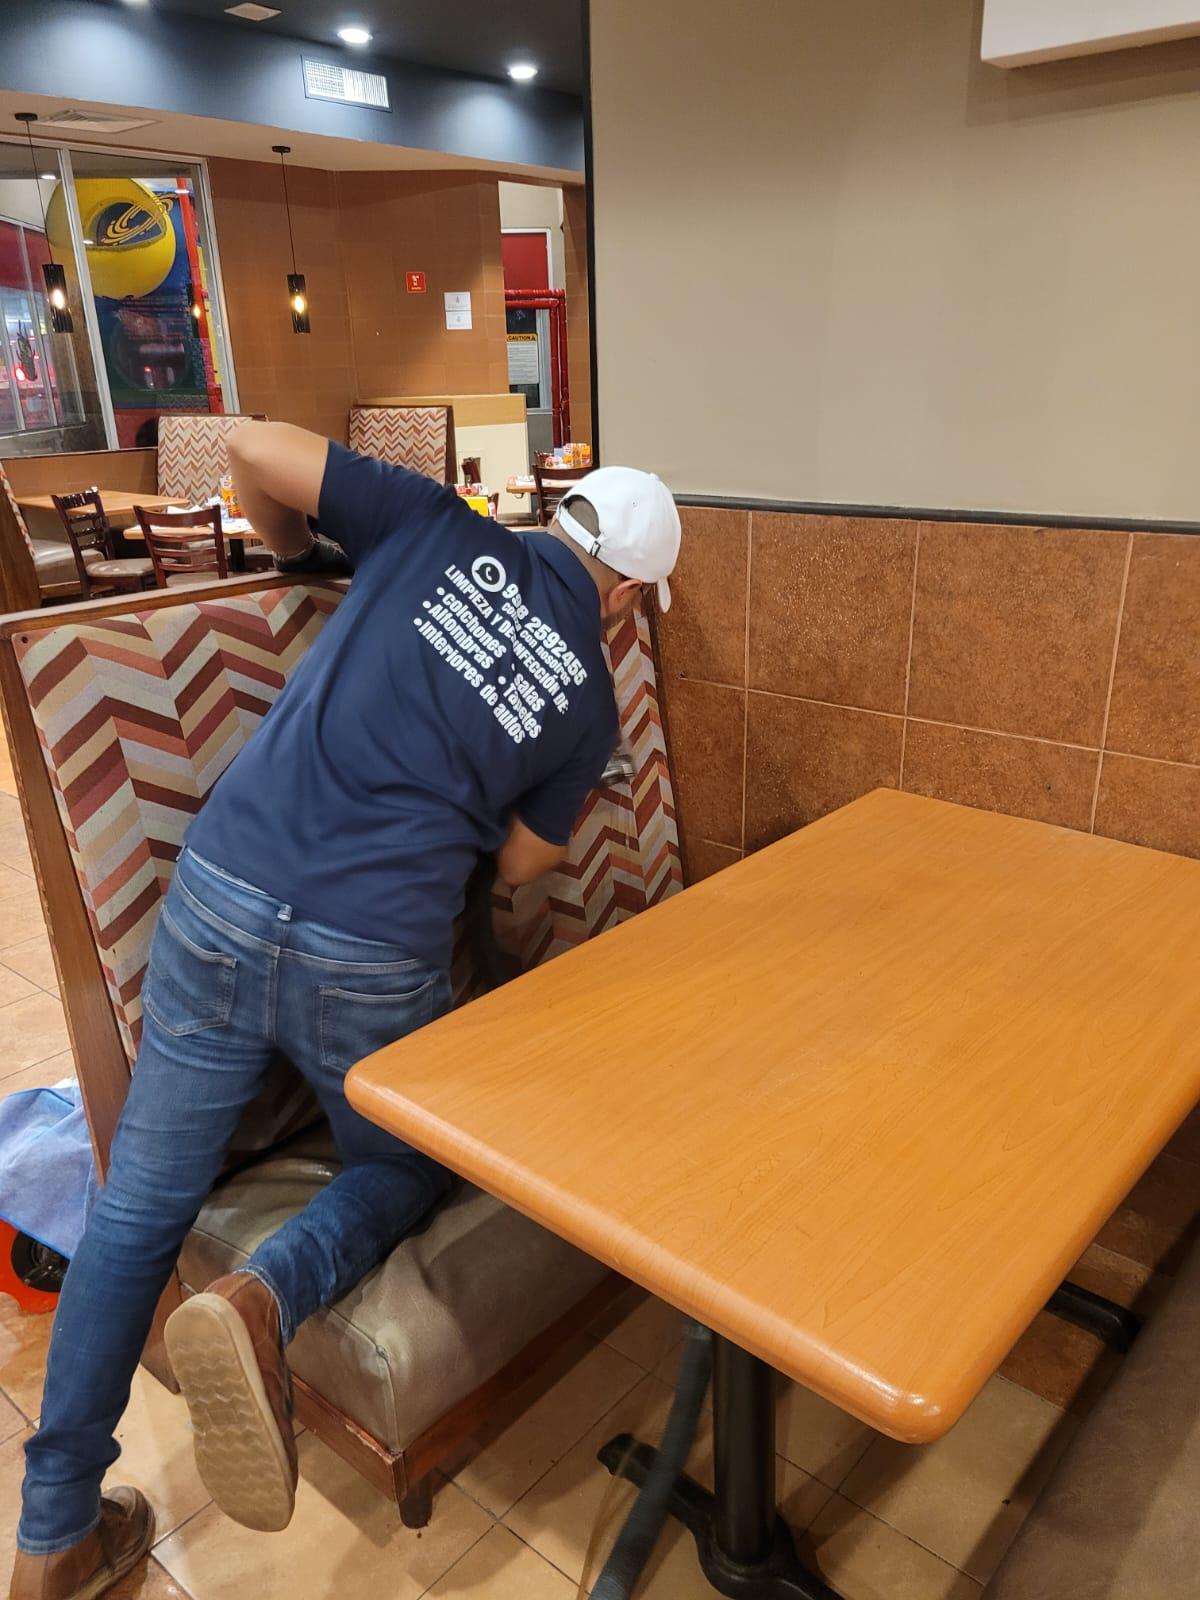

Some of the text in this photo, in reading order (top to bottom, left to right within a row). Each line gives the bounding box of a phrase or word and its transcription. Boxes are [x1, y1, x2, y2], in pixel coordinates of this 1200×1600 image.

[442, 593, 507, 659] colchones
[444, 564, 494, 619] LIMPIEZA
[490, 613, 503, 627] Y
[428, 602, 495, 670] Alfombras
[519, 630, 571, 686] con nosotros
[524, 617, 588, 686] 2592455
[418, 620, 526, 744] Interiores de autos
[503, 682, 542, 739] Tapetes
[514, 673, 545, 712] salas
